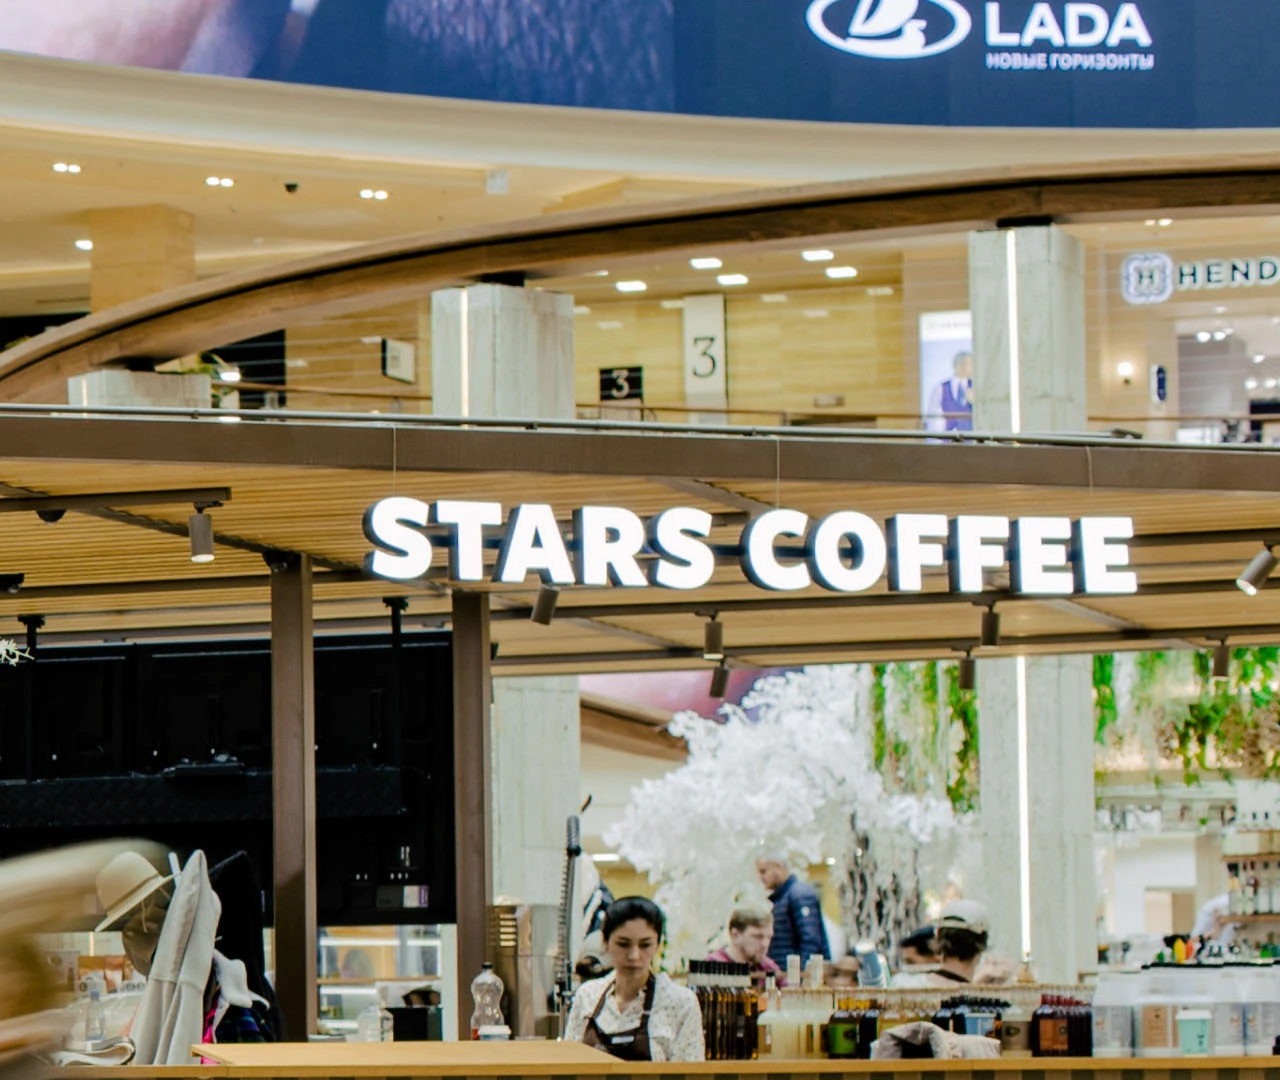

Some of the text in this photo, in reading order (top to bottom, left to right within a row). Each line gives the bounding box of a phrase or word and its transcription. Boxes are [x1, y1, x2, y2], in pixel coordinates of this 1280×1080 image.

[985, 2, 1153, 47] LADA
[986, 52, 1154, 70] НОВЫЕ ГОРИЗОНТЫ
[692, 336, 716, 378] 3
[611, 369, 630, 398] 3
[363, 496, 1138, 594] STARS COFFEE
